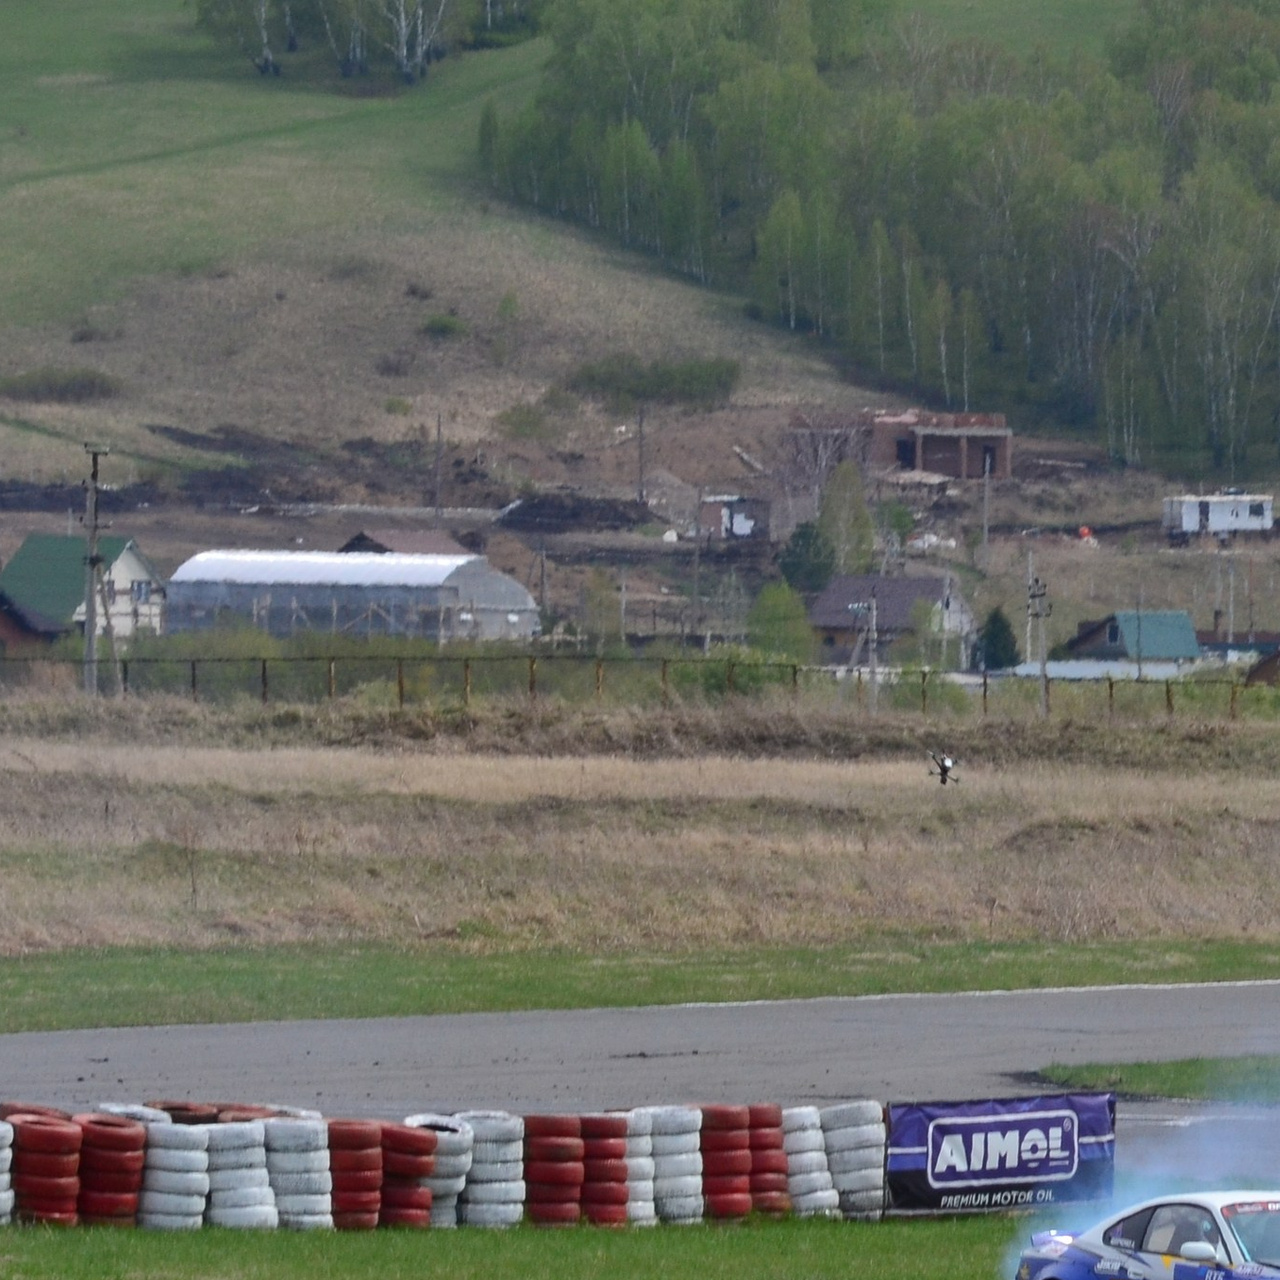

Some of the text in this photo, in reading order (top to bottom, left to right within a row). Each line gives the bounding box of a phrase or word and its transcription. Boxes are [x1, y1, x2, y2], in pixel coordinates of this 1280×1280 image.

[934, 1126, 1070, 1173] AIMOL
[940, 1188, 1055, 1209] PREMIUM MOTOR OIL
